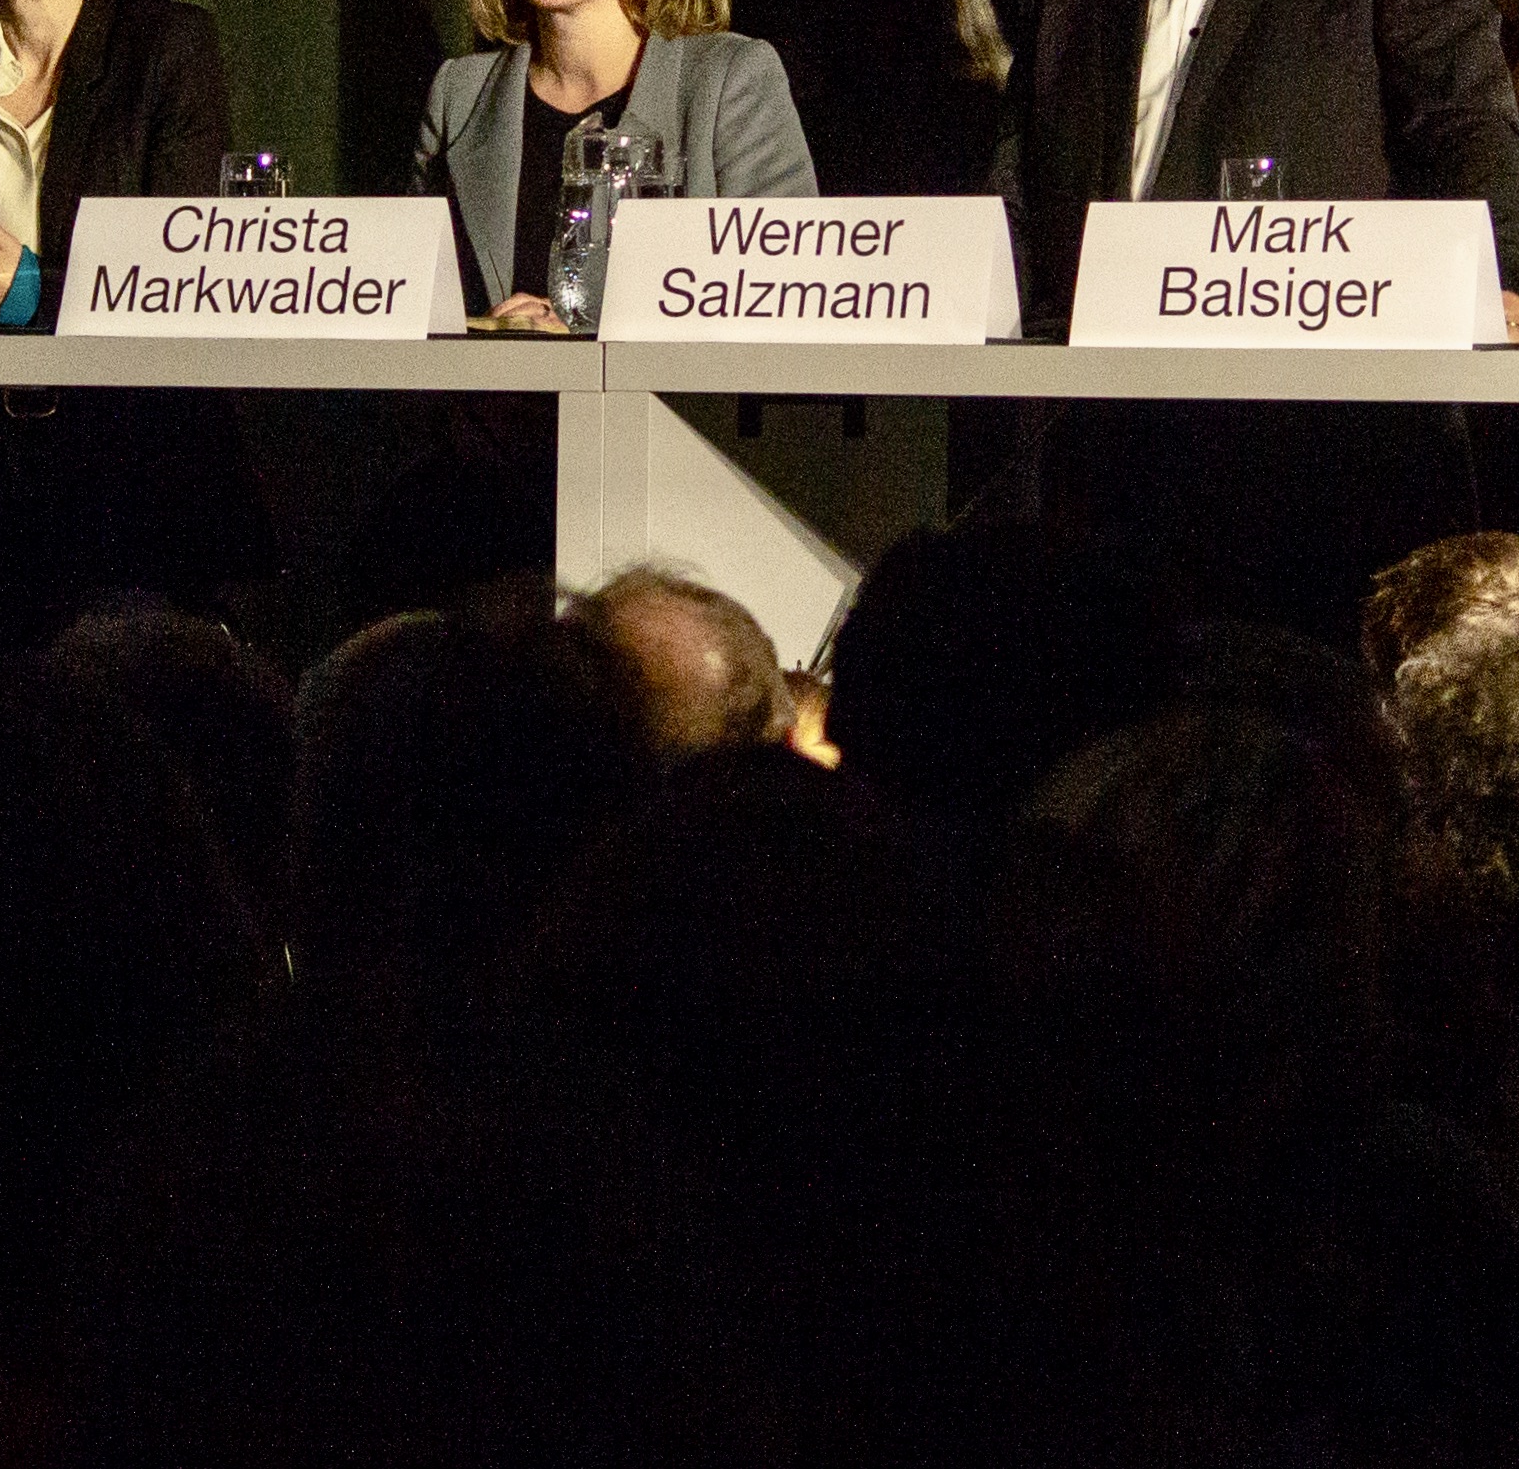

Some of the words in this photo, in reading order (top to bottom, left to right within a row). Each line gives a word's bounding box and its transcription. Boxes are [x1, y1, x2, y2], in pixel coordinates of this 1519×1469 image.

[162, 205, 348, 253] Christa
[709, 208, 905, 256] Werner
[1211, 206, 1351, 253] Mark
[91, 265, 407, 315] Markwalder
[659, 268, 930, 319] Salzmann
[1159, 267, 1392, 331] Balsiger
